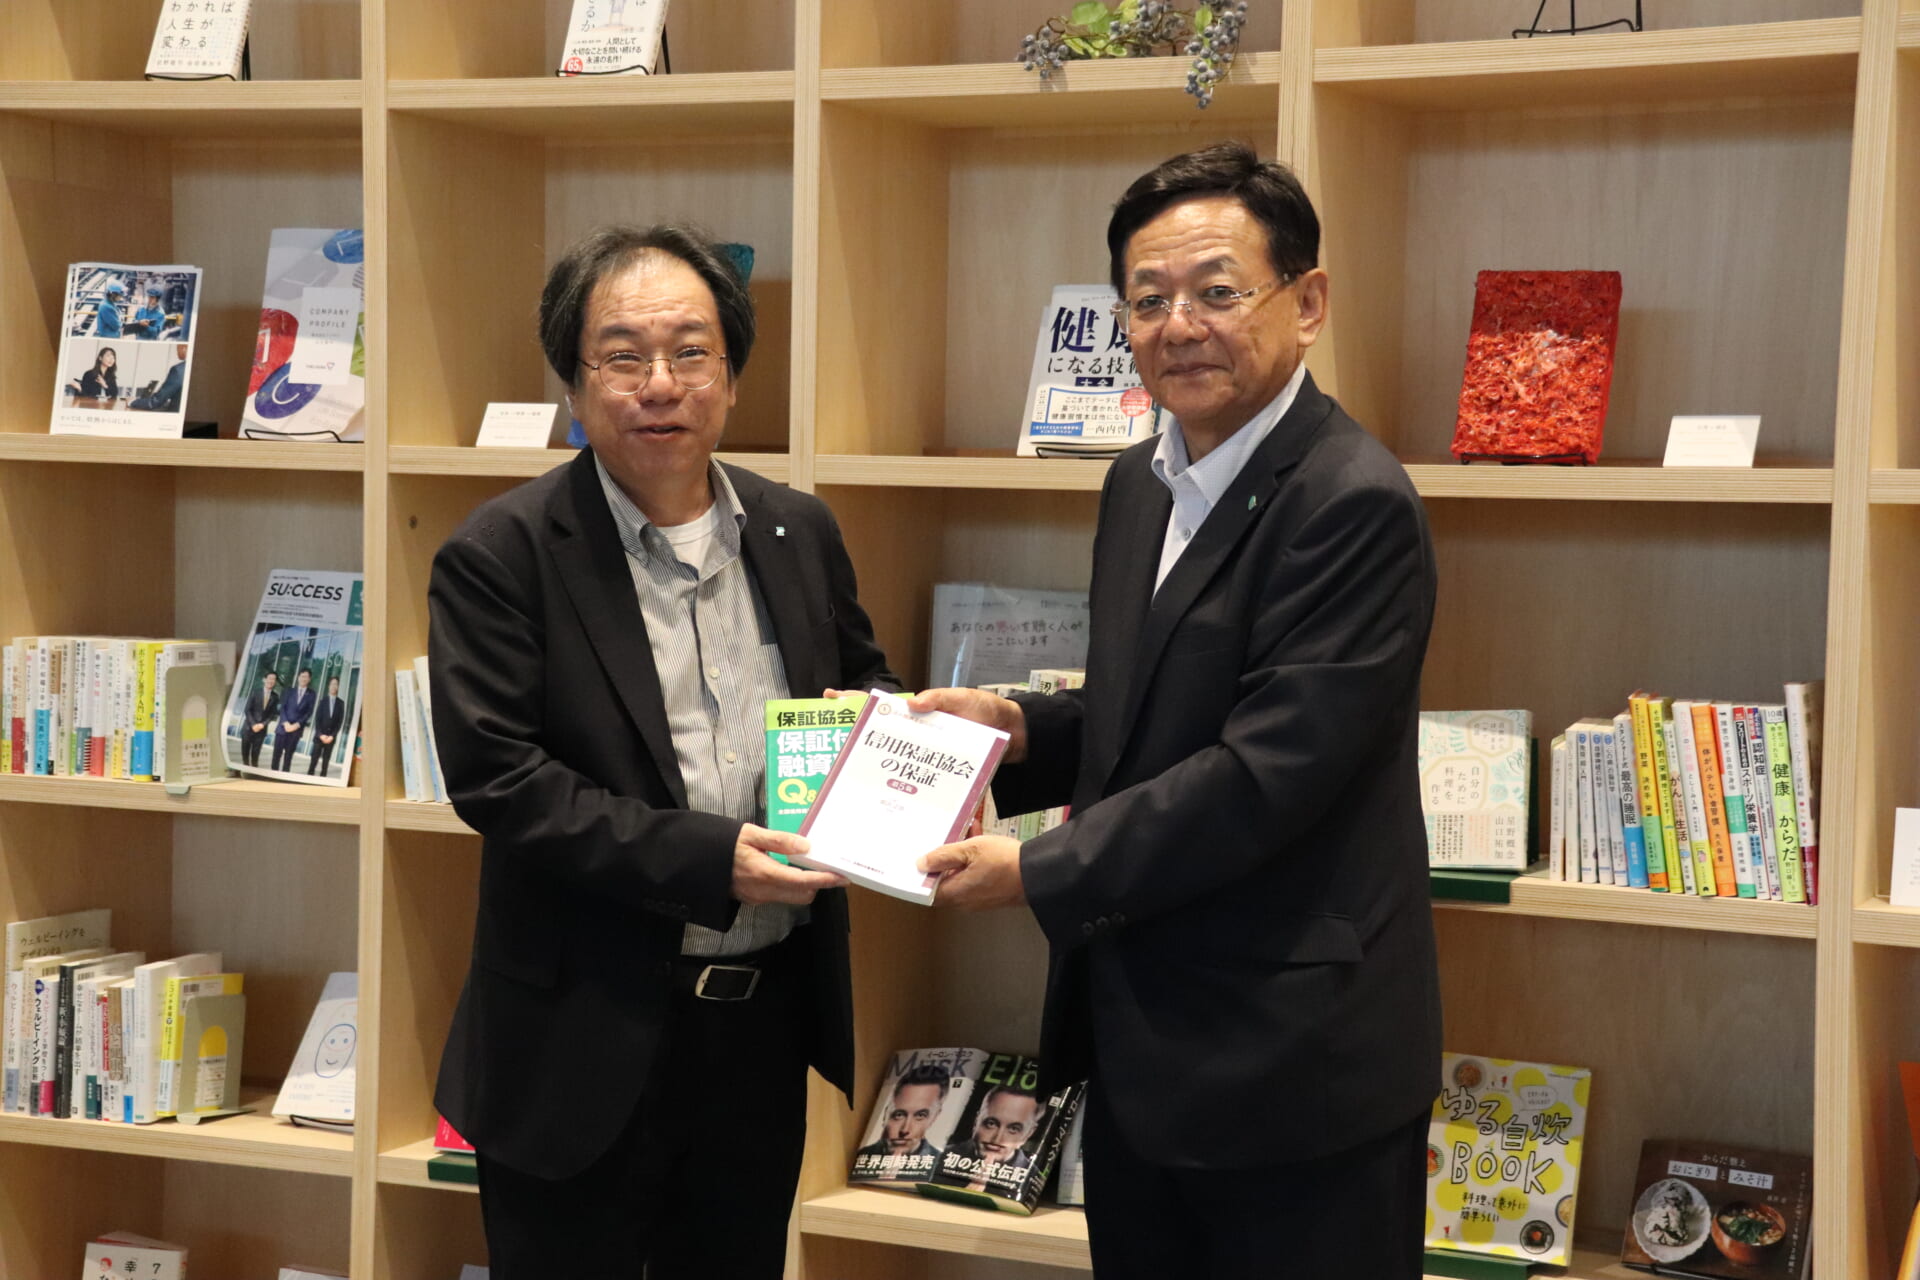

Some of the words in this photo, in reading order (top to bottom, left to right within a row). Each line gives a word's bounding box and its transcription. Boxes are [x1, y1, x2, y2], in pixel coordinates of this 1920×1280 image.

[171, 2, 234, 13] わかれば
[166, 17, 213, 30] 人生が
[162, 36, 207, 48] 変わる
[606, 37, 637, 45] 人間として
[309, 307, 350, 316] COMPANY
[309, 320, 346, 329] PROFILE
[985, 635, 1049, 646] ここにいます
[777, 708, 856, 727] 保証協会
[777, 753, 840, 778] 融資
[864, 730, 975, 779] 信用保証協会
[1752, 743, 1766, 776] 認知症
[880, 758, 940, 788] の保証
[1443, 765, 1455, 800] 料理を
[1470, 765, 1480, 800] 自分の
[1456, 771, 1467, 805] ために
[1620, 770, 1637, 825] 最高の睡眠
[1670, 775, 1682, 798] がん
[1742, 769, 1758, 834] スポーツ栄養学
[1675, 818, 1688, 842] 生活
[1441, 1084, 1573, 1152] ゆる自炊
[855, 1154, 935, 1170] 世界同時発売
[943, 1151, 1028, 1184] 初の公式伝記
[1450, 1140, 1555, 1195] BOOK
[1671, 1163, 1711, 1178] おにぎり
[1732, 1173, 1770, 1187] みそ汁
